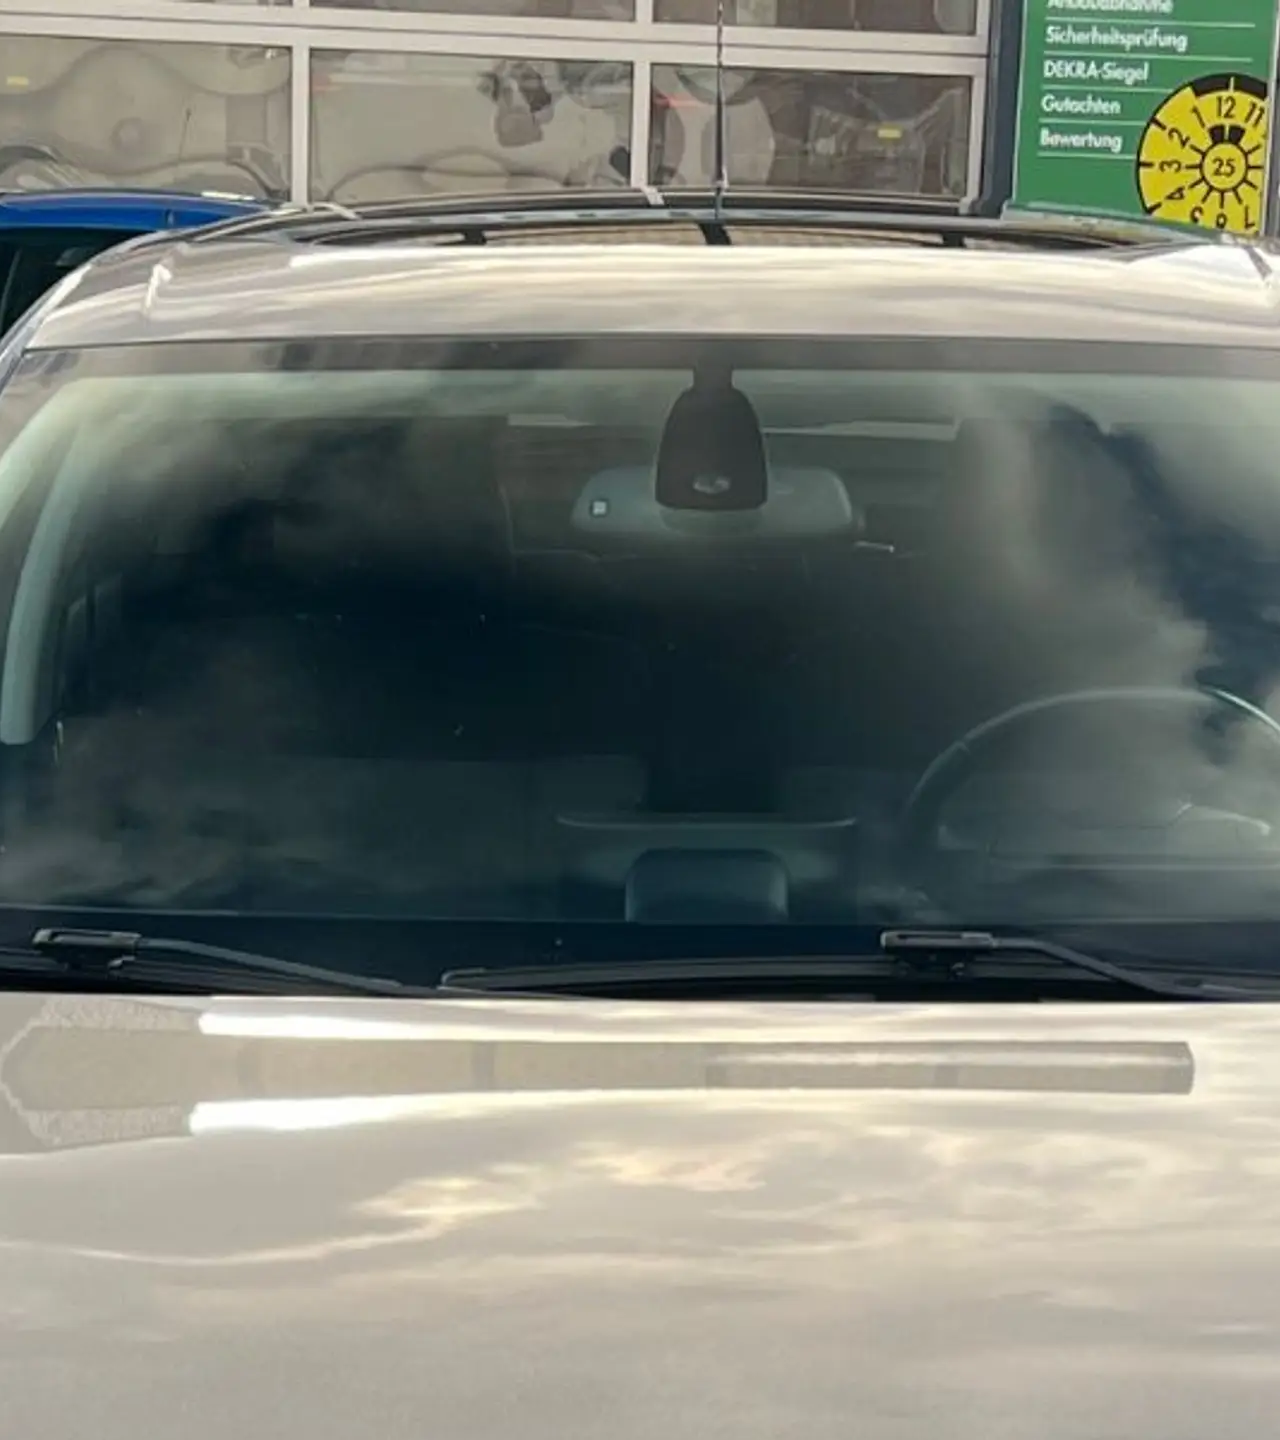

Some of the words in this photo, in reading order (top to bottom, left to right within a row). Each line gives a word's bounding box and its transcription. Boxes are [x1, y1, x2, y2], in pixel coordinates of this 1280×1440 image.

[1045, 25, 1187, 52] Sicherheitsprüfung
[1043, 60, 1150, 85] DEKRA-Siegel
[1041, 93, 1121, 114] Gutachten
[1217, 96, 1236, 119] 12
[1040, 127, 1122, 153] Bewertung
[1211, 158, 1237, 178] 25
